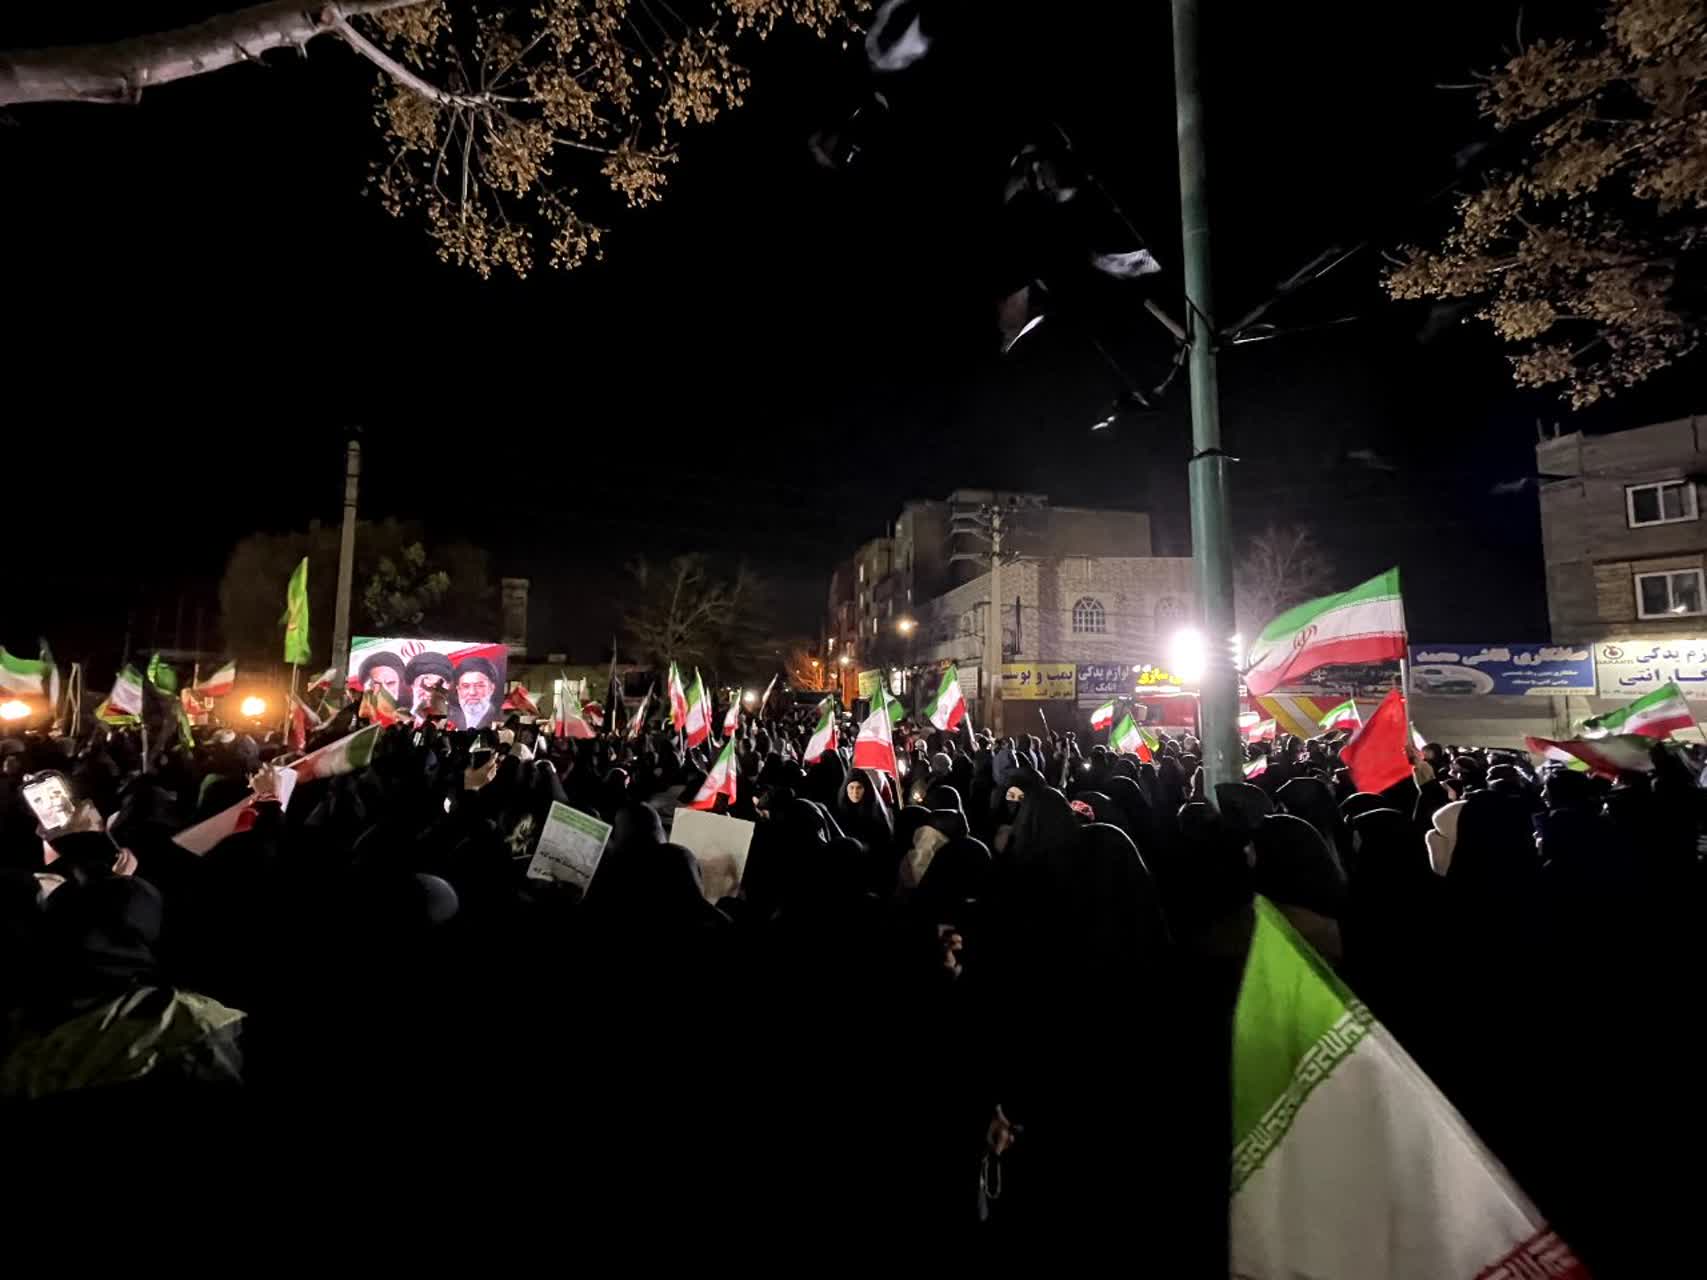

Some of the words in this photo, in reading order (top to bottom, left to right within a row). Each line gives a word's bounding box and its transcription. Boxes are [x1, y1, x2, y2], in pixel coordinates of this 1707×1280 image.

[1636, 646, 1680, 663] یدکی
[1002, 670, 1031, 686] بوست
[1036, 671, 1043, 686] و
[1078, 665, 1104, 681] یدکی
[1106, 664, 1129, 681] لوازم
